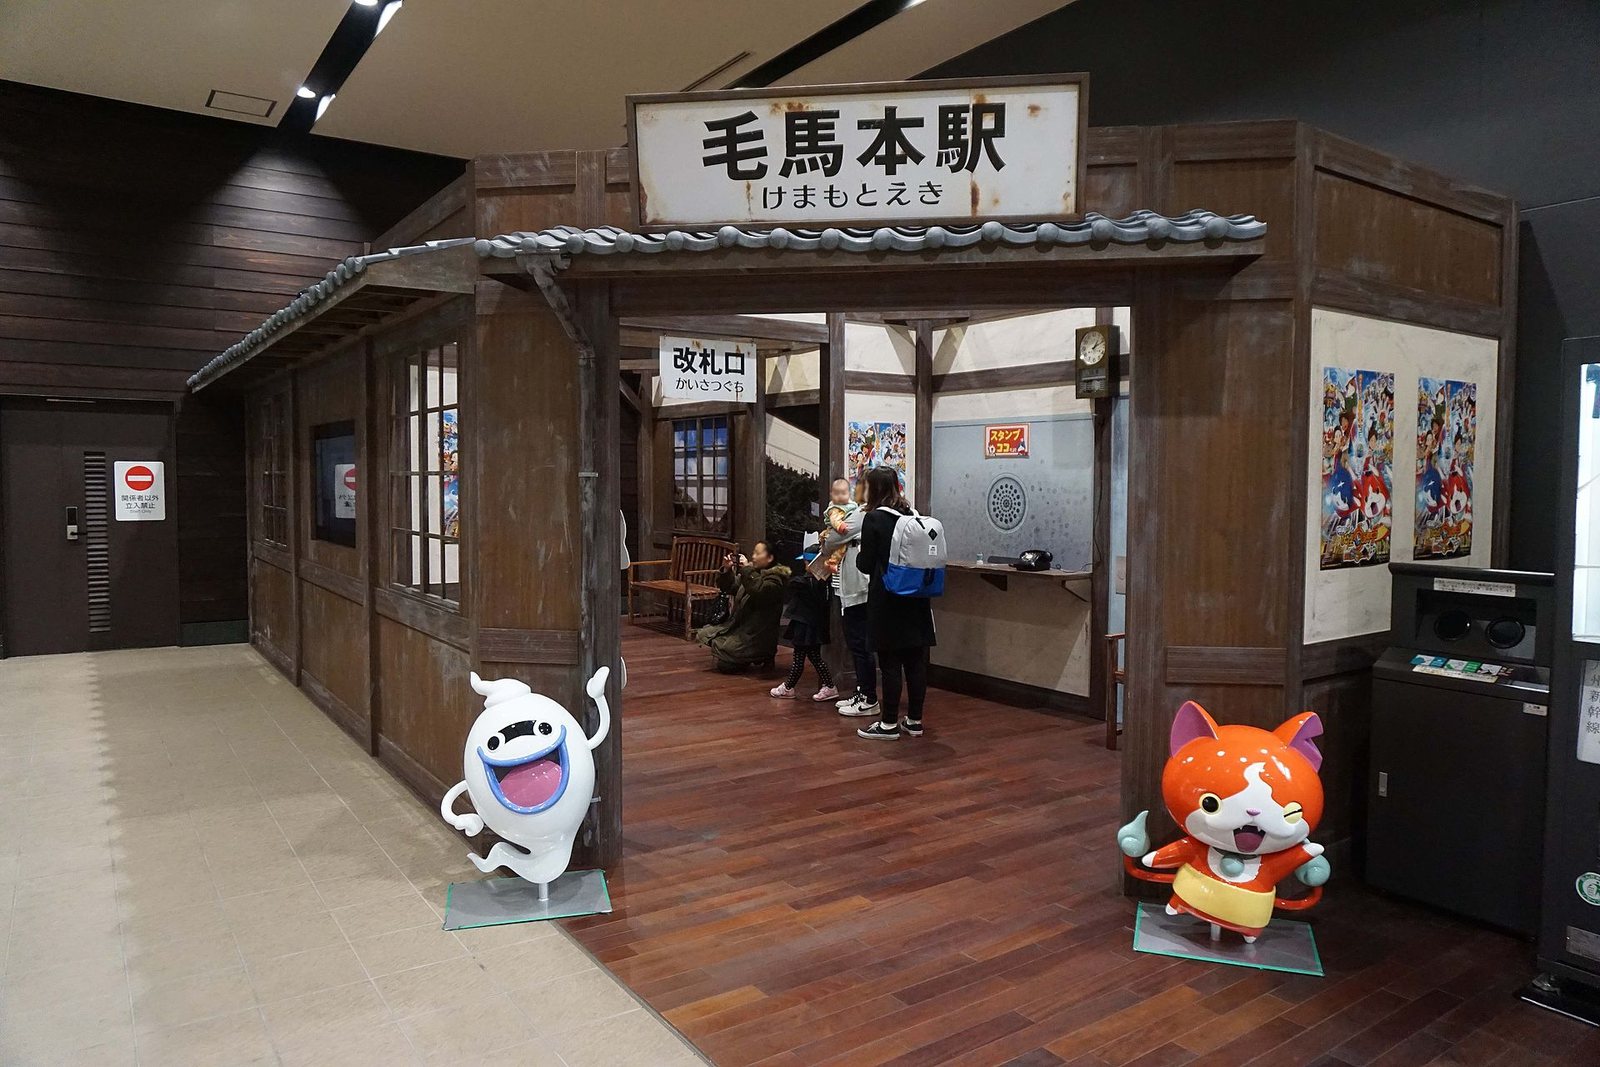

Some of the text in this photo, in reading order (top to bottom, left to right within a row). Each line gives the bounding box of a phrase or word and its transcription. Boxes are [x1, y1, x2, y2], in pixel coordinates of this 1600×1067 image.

[701, 102, 1006, 181] 毛馬本駅
[761, 180, 943, 210] けまもとえき
[673, 346, 745, 376] 改札口
[676, 377, 744, 393] かいさつぐち
[990, 429, 1020, 441] スタンプ
